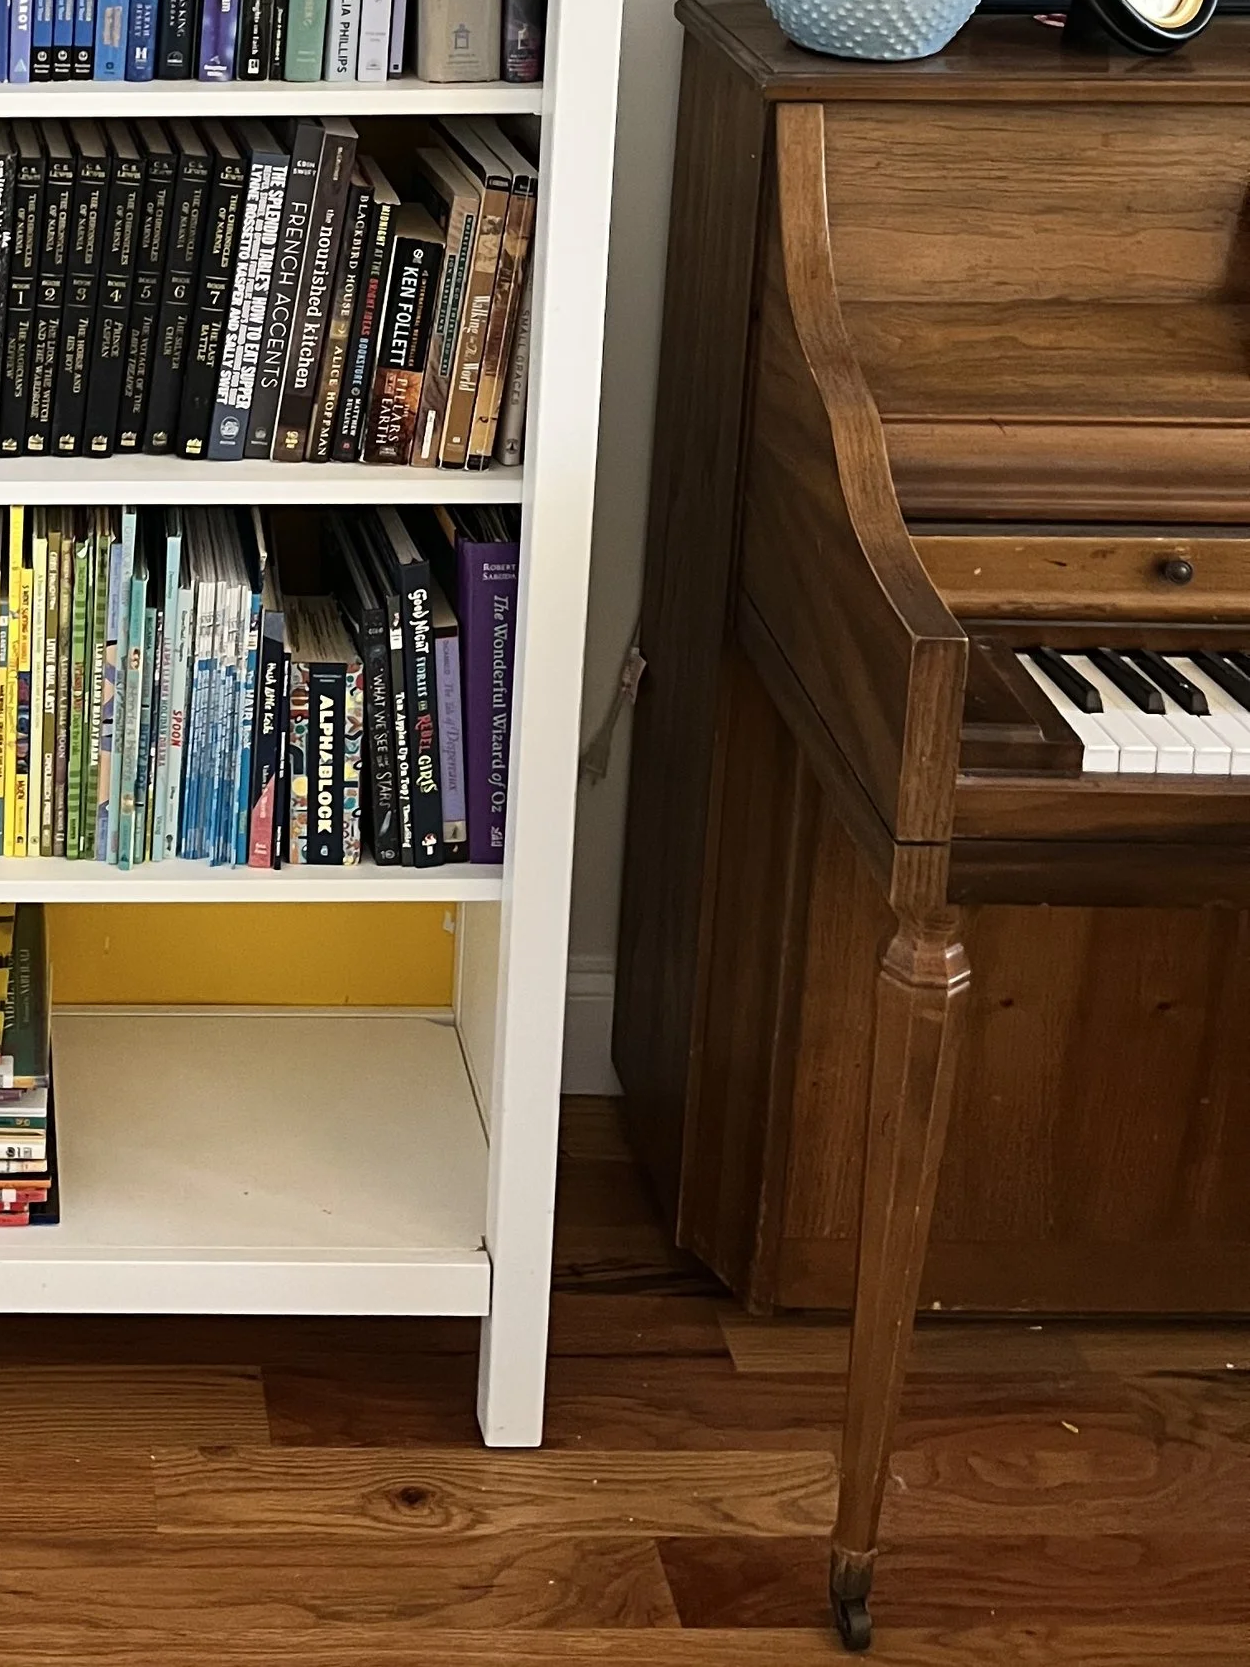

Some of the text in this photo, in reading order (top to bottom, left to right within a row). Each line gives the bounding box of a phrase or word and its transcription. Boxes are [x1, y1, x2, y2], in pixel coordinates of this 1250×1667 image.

[337, 21, 350, 73] PHILLIPS
[18, 292, 23, 303] 1
[45, 289, 55, 300] 2
[110, 290, 122, 302] 4
[174, 286, 185, 298] 6
[210, 292, 219, 304] 7
[262, 202, 307, 389] FRENCH ACCENTS
[295, 209, 335, 389] the nourished kitchen
[390, 266, 419, 366] KEN FOLLETT
[493, 623, 508, 709] Wonderful
[171, 710, 182, 746] SPOON
[491, 713, 507, 769] Wizard
[318, 694, 333, 833] ALPHABLOCK
[488, 772, 505, 788] of
[490, 792, 506, 813] Oz
